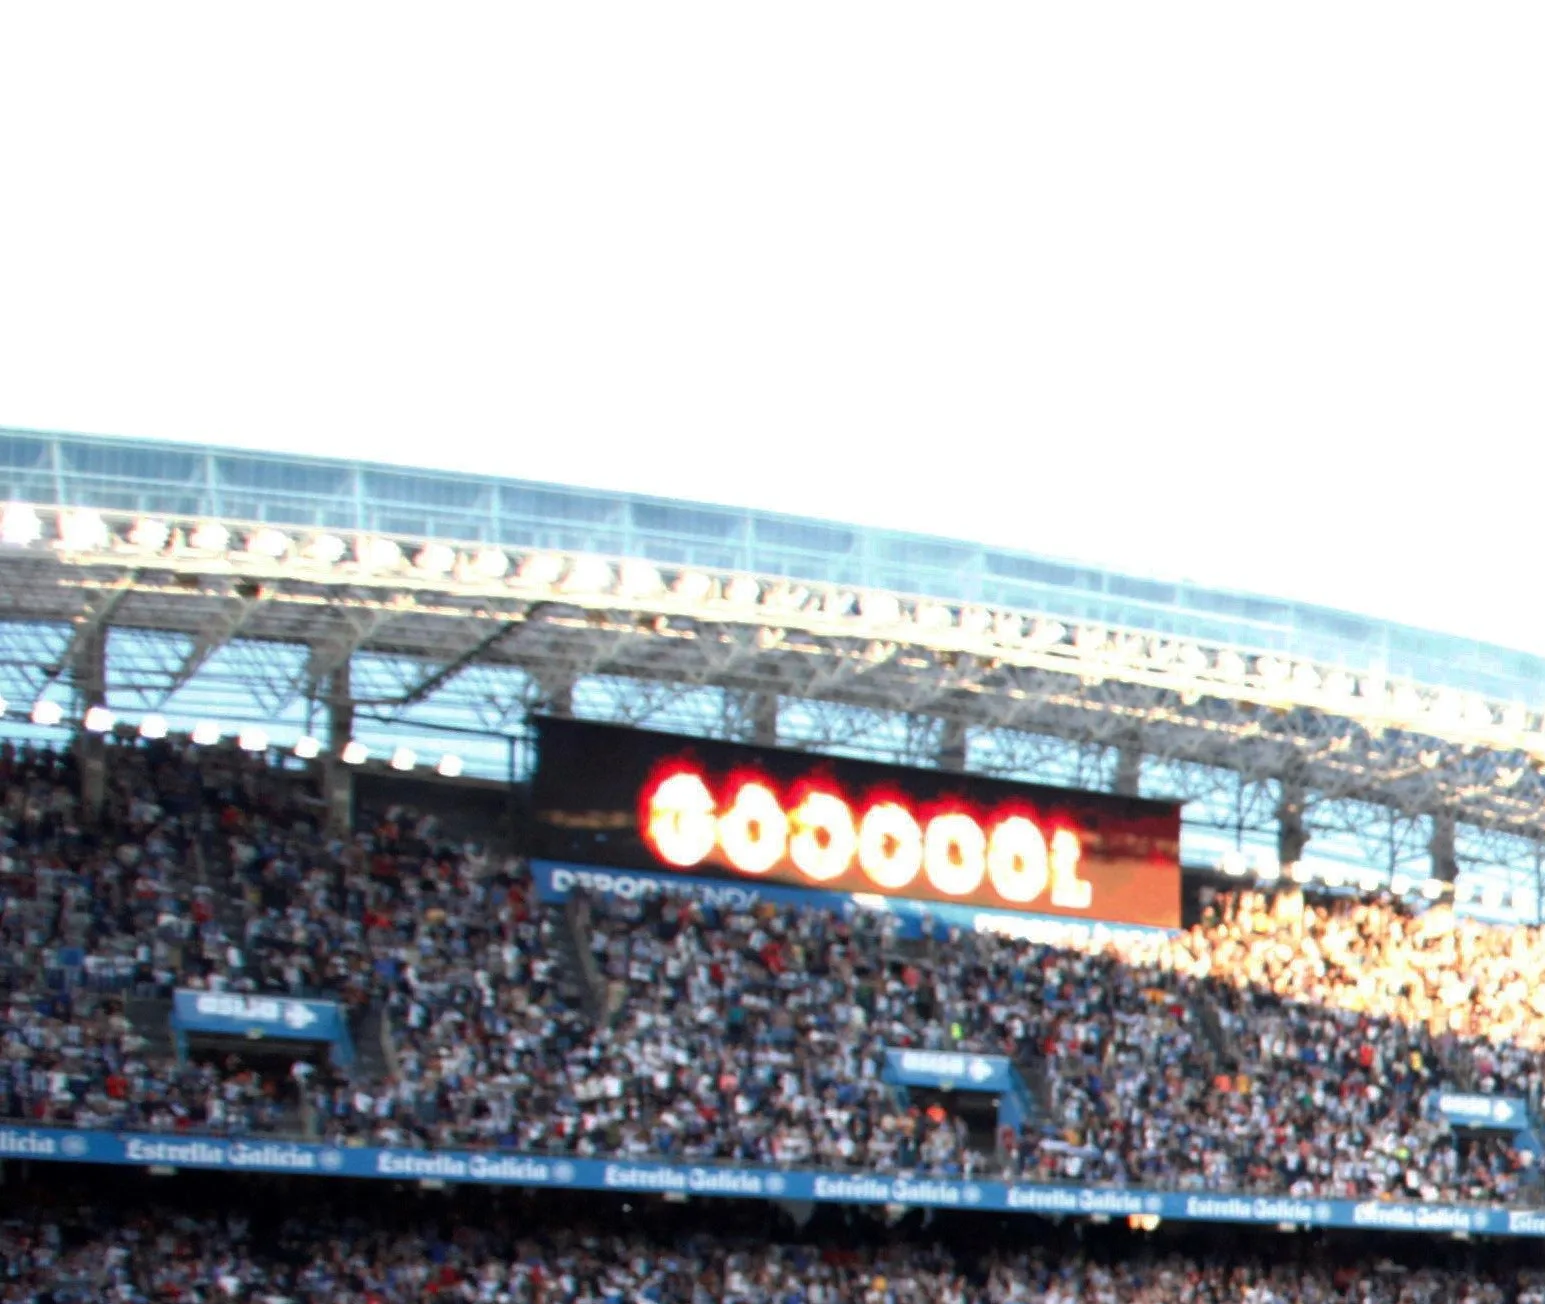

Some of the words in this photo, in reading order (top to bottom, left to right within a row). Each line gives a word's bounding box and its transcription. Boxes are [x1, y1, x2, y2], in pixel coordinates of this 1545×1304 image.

[126, 1139, 222, 1165] Estrella
[228, 1142, 314, 1168] Galicia
[377, 1151, 464, 1177] Estrella
[469, 1156, 548, 1181] Galicia
[606, 1164, 685, 1188] Estrella
[690, 1167, 761, 1194] Galicia
[814, 1175, 889, 1199] Estrella
[893, 1179, 959, 1203] Galicia
[1008, 1188, 1076, 1210] Estrella
[1081, 1192, 1142, 1212] Galicia
[1187, 1198, 1251, 1218] Estrella
[1254, 1200, 1312, 1221] Galicia
